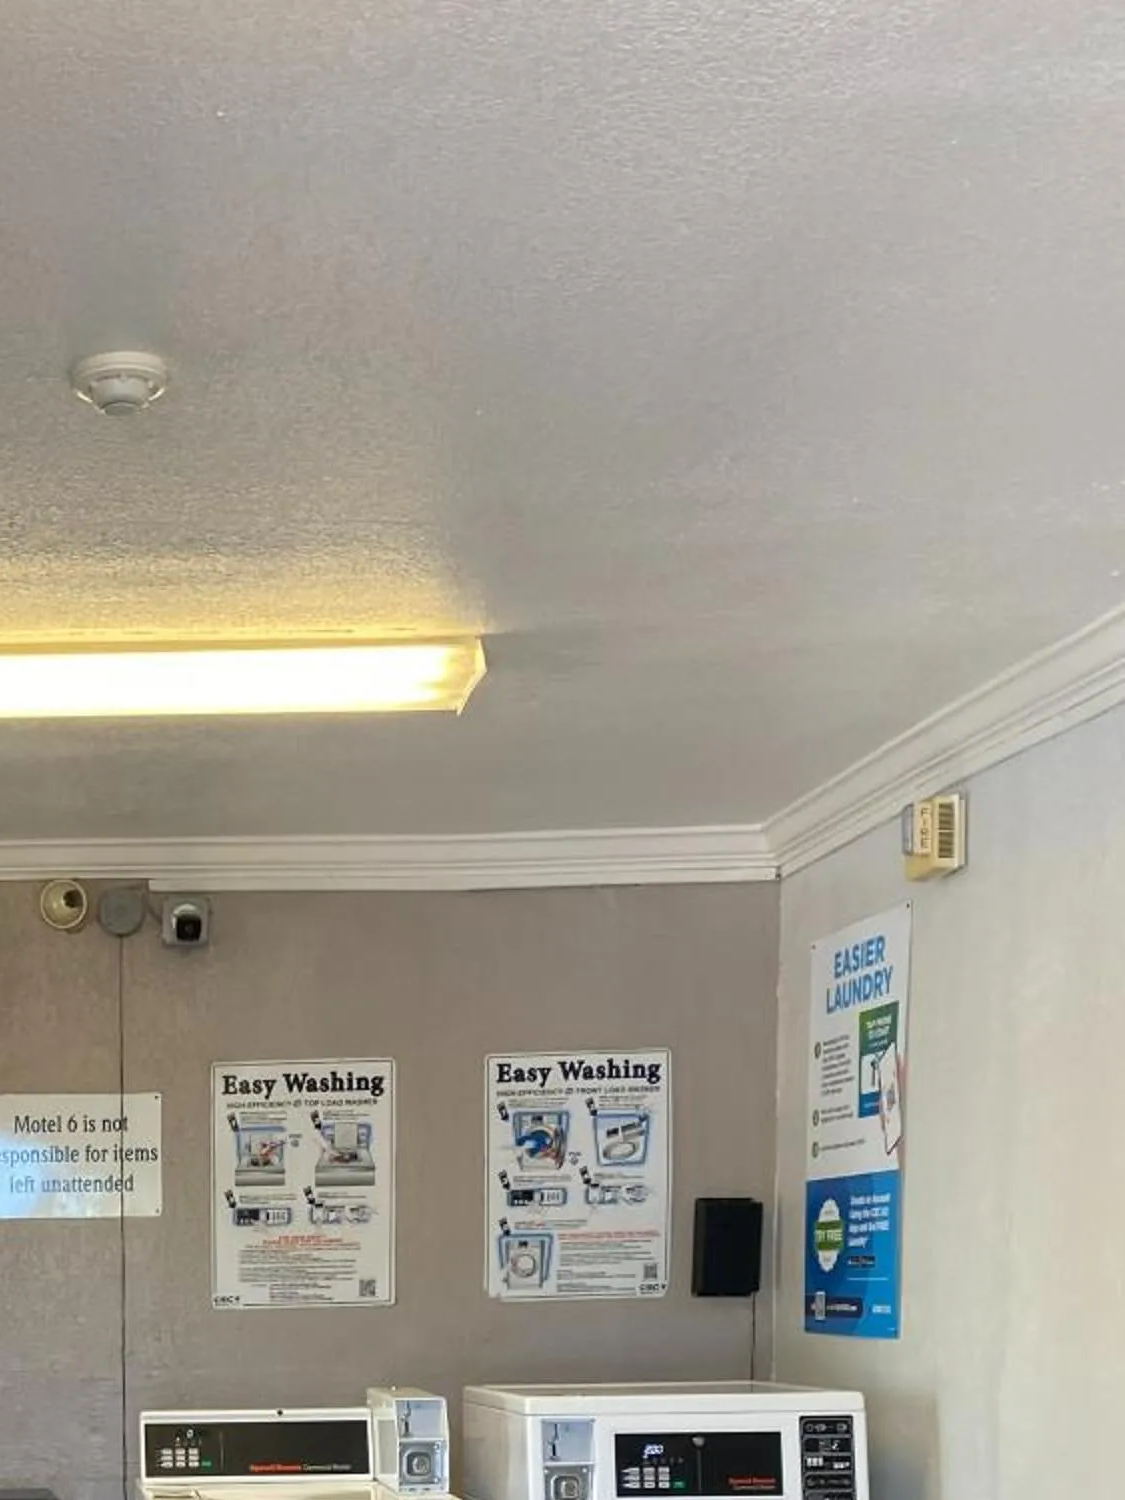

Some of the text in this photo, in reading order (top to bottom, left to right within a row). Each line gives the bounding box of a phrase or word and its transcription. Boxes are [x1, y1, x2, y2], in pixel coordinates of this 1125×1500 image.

[833, 935, 885, 978] EASIER
[826, 964, 894, 1014] LAUNDRY
[222, 1071, 385, 1099] Easy Washing
[496, 1059, 662, 1087] Easy Washing
[14, 1114, 128, 1134] Motel 6 is not
[85, 1143, 108, 1163] for
[10, 1174, 134, 1194] left unattended
